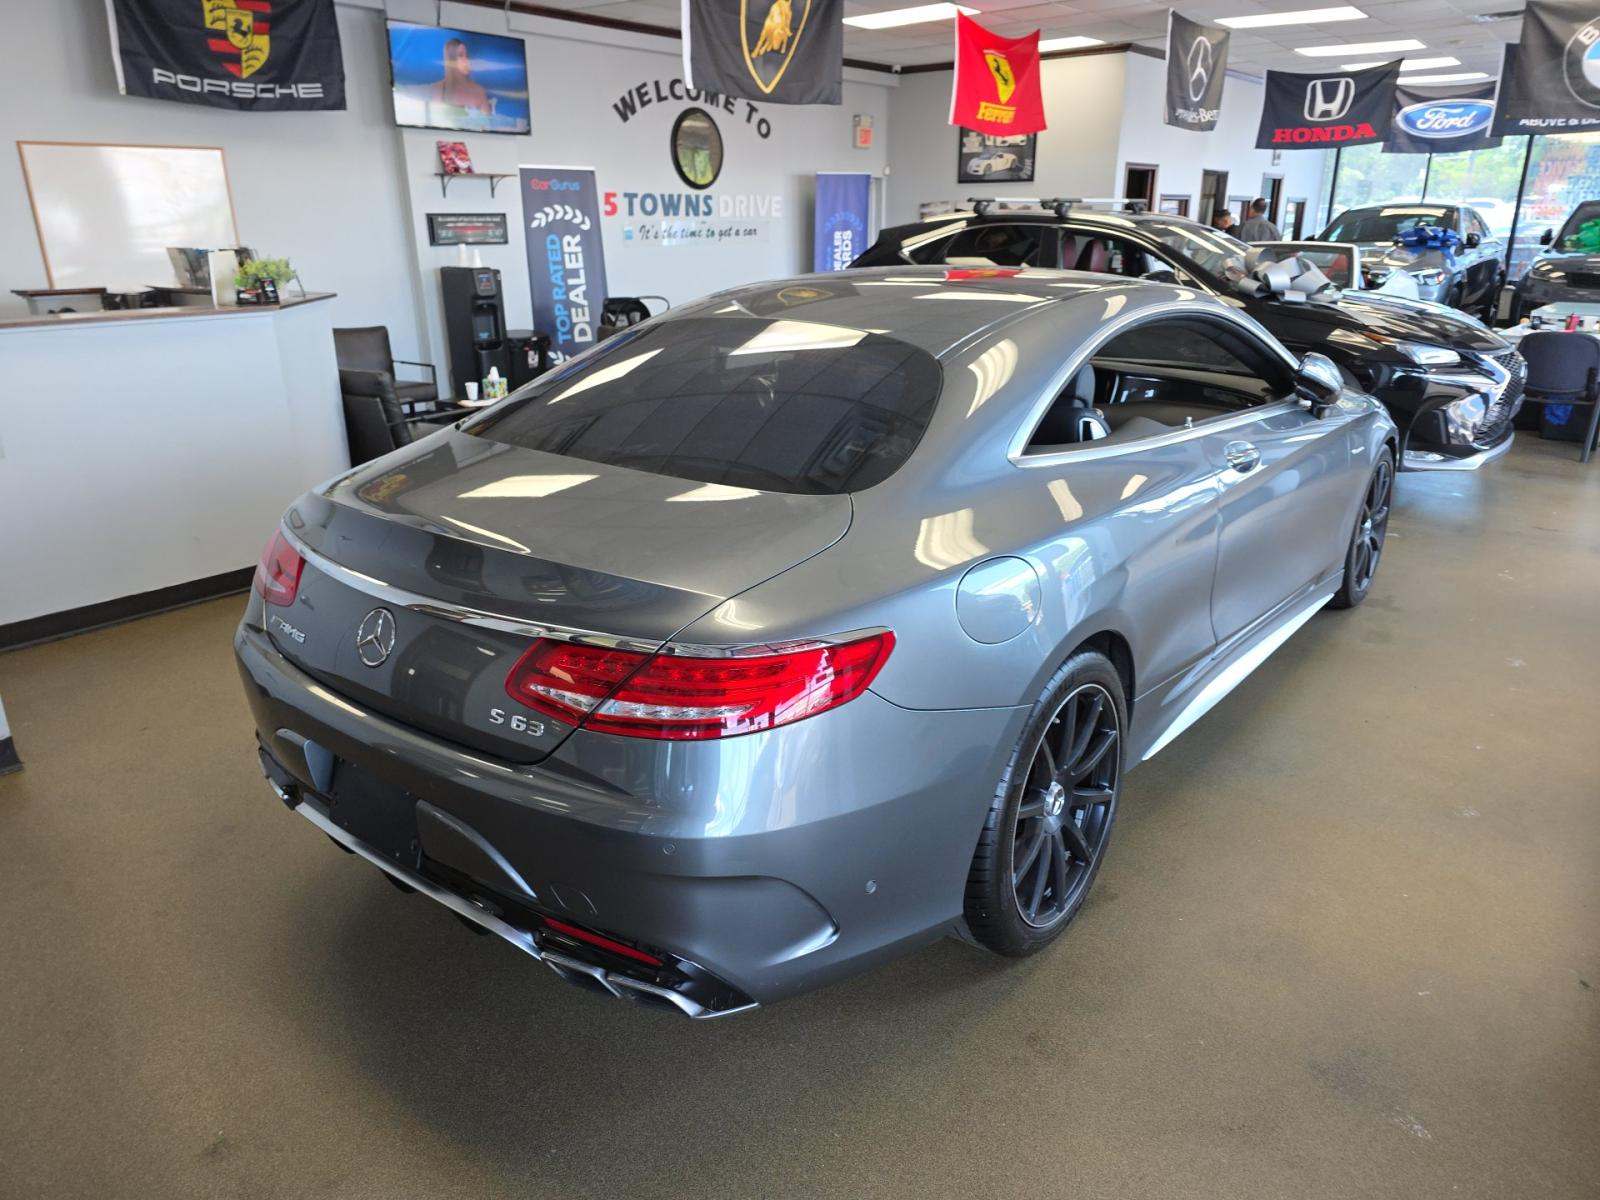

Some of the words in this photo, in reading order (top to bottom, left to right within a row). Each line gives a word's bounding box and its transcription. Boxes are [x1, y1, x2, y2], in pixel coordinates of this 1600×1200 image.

[152, 68, 324, 98] PORSCHE
[744, 102, 771, 139] TO
[976, 101, 1016, 124] Ferrari
[1416, 107, 1478, 130] Ford
[1272, 122, 1377, 143] HONDA
[604, 192, 618, 217] 5
[623, 192, 713, 217] TOWNS
[719, 194, 784, 218] DRIVE
[706, 228, 716, 239] to
[718, 225, 733, 241] get
[743, 228, 758, 237] car
[546, 233, 567, 301] RATED
[562, 233, 593, 343] DEALER
[554, 305, 572, 344] TOP
[489, 708, 505, 724] S
[511, 715, 545, 737] 63
